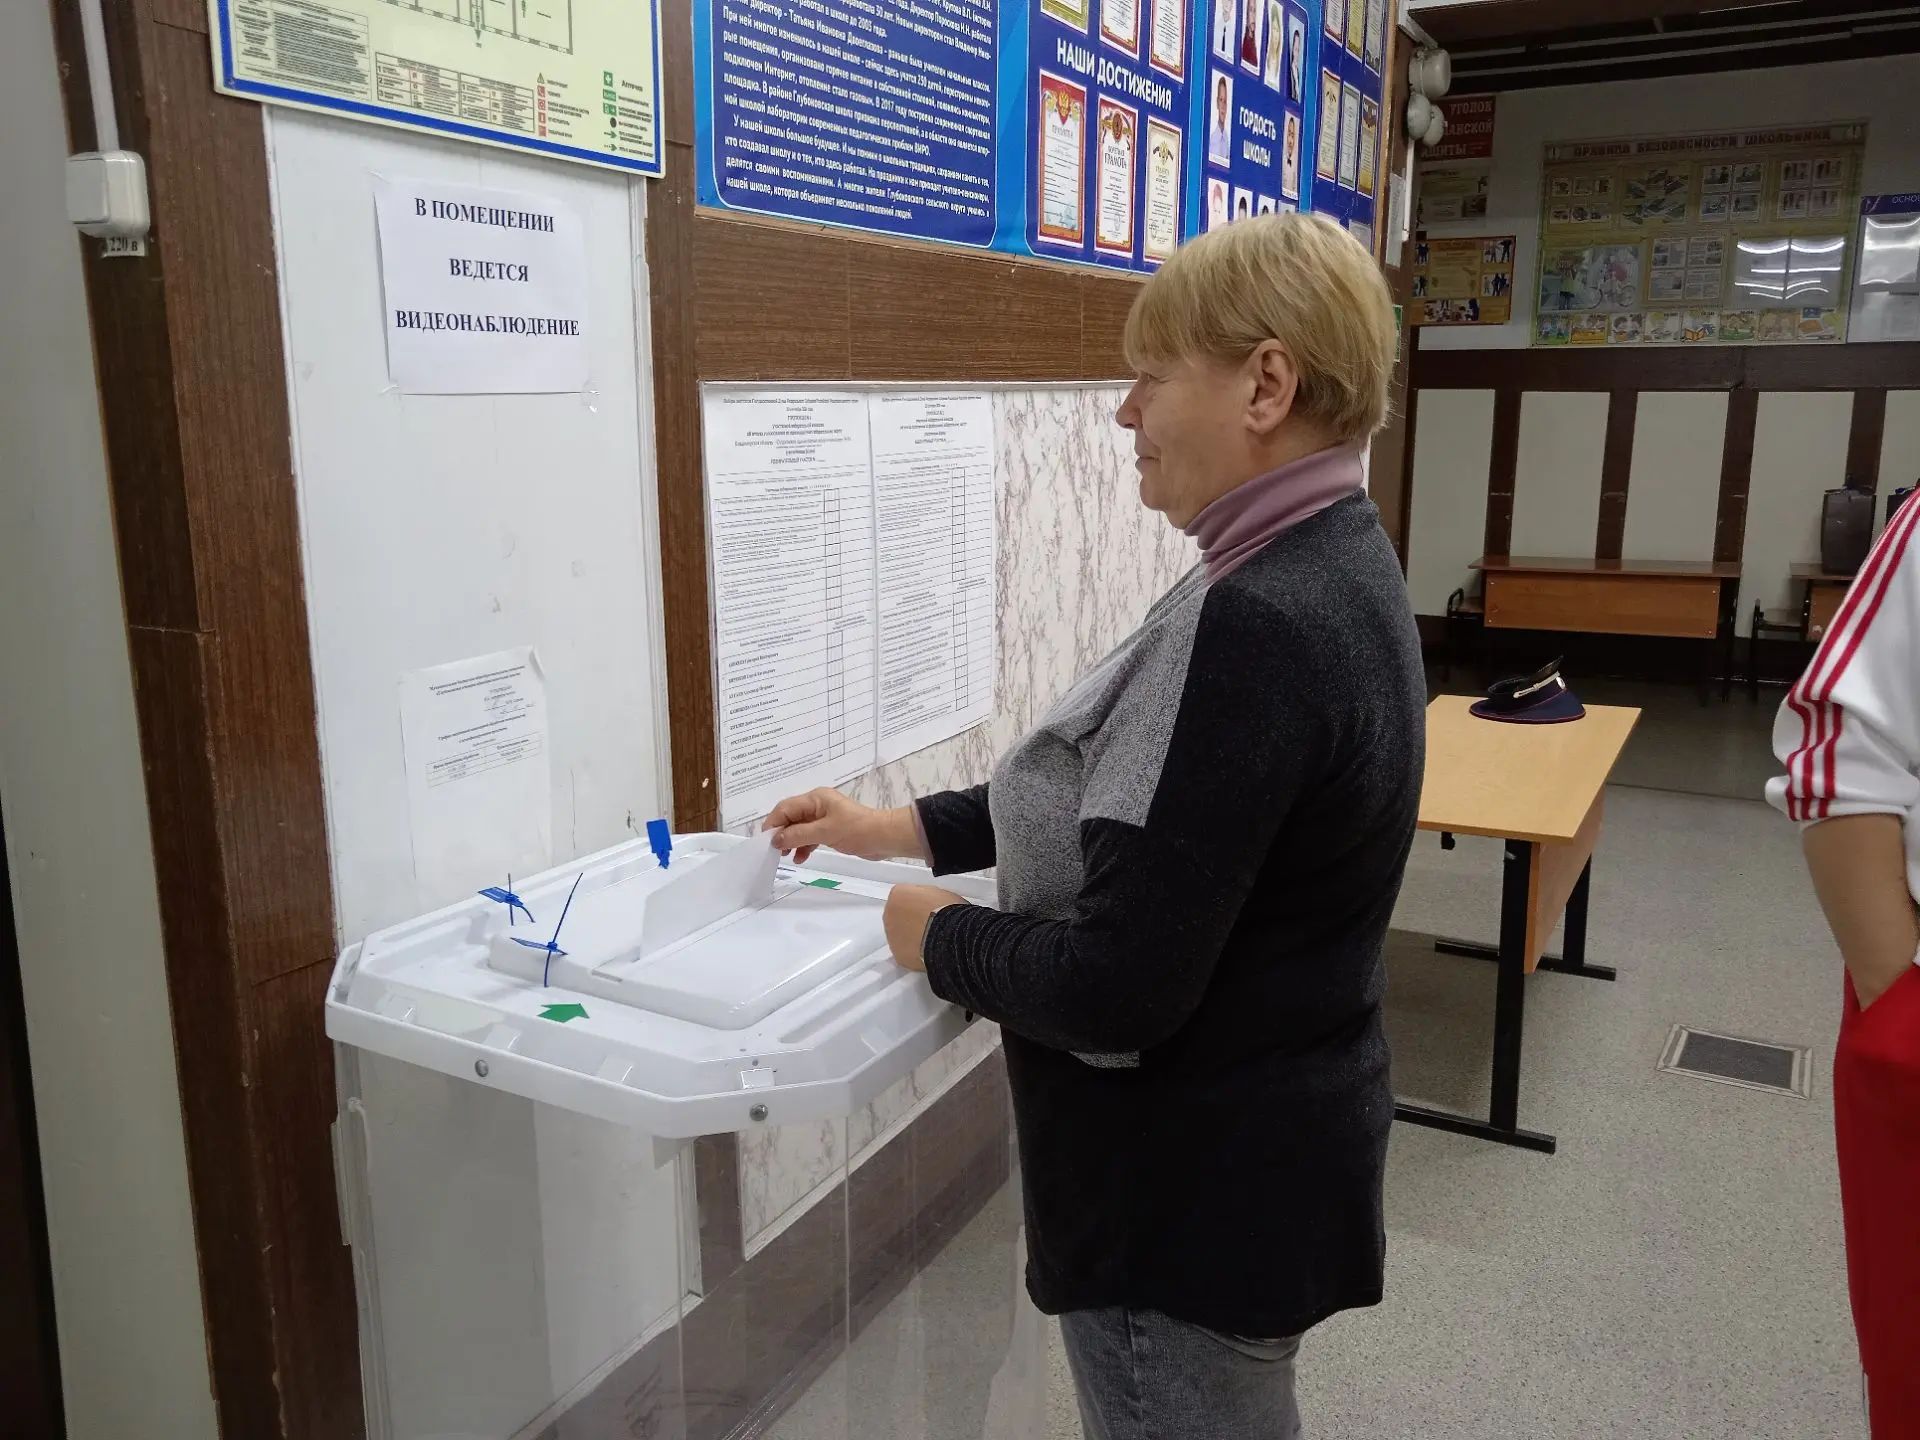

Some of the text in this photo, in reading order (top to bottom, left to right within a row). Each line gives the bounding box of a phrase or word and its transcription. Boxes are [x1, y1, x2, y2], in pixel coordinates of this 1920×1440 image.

[723, 6, 738, 24] При
[739, 13, 752, 27] ней
[753, 20, 777, 36] многое
[779, 29, 816, 49] изменилось
[822, 44, 842, 58] нашей
[842, 51, 860, 64] школе
[789, 9, 815, 29] Татьяна
[817, 19, 846, 40] Ивановна
[723, 30, 738, 43] рые
[739, 35, 780, 60] помещения,
[782, 50, 824, 71] организовано
[723, 52, 763, 72] подключен
[764, 61, 797, 85] Интернет,
[799, 75, 830, 92] отопление
[832, 85, 848, 97] стало
[724, 73, 761, 91] площадка.
[769, 84, 792, 100] районе
[1057, 37, 1172, 111] НАШИ ДОСТИЖЕНИЯ
[724, 92, 737, 105] ной
[739, 98, 765, 112] школой
[767, 104, 808, 125] лаборатории
[1239, 106, 1277, 141] ГОРДОСТЬ
[740, 119, 763, 132] нашей
[764, 125, 785, 138] школы
[786, 127, 813, 144] большое
[814, 134, 841, 151] будущее.
[725, 135, 737, 146] кто
[739, 139, 769, 153] создавал
[770, 146, 791, 162] школу
[802, 153, 814, 166] тех,
[815, 156, 825, 166] кто
[826, 159, 842, 170] здесь
[726, 157, 753, 170] делятся
[755, 163, 780, 175] своими
[1243, 139, 1271, 169] ШКОЛЫ
[726, 176, 749, 189] нашей
[750, 181, 773, 196] школе,
[774, 186, 799, 200] которая
[414, 197, 555, 233] В ПОМЕЩЕНИИ
[110, 237, 128, 252] 220
[449, 258, 529, 282] ВЕДЕТСЯ
[395, 309, 580, 338] ВИДЕОНАБЛЮДЕНИЕ
